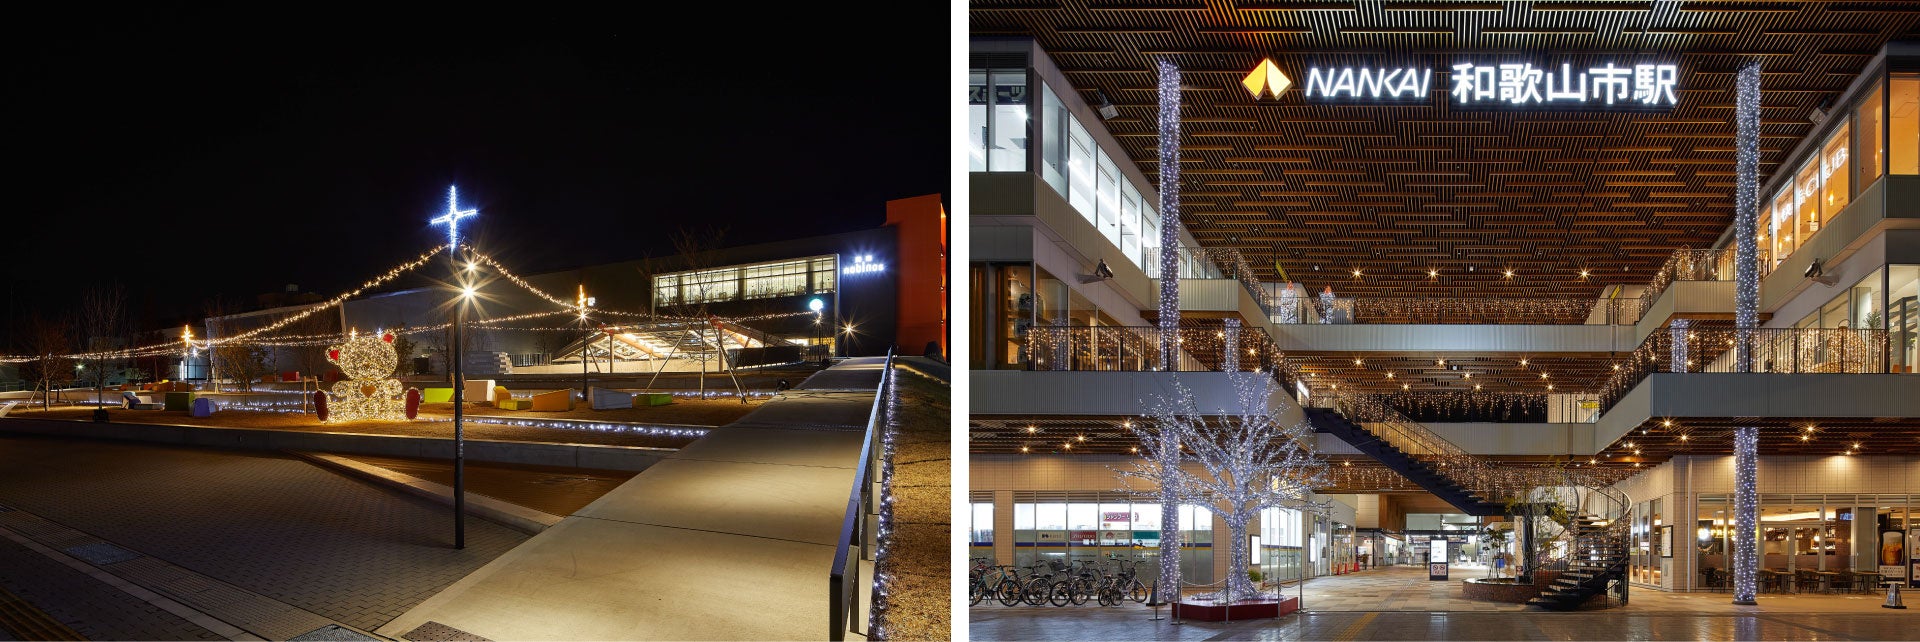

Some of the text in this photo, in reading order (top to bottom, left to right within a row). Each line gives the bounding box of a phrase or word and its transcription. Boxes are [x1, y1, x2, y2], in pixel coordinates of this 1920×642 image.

[969, 86, 1025, 102] スーツ
[1306, 62, 1678, 106] NANKAI 和歌山市駅
